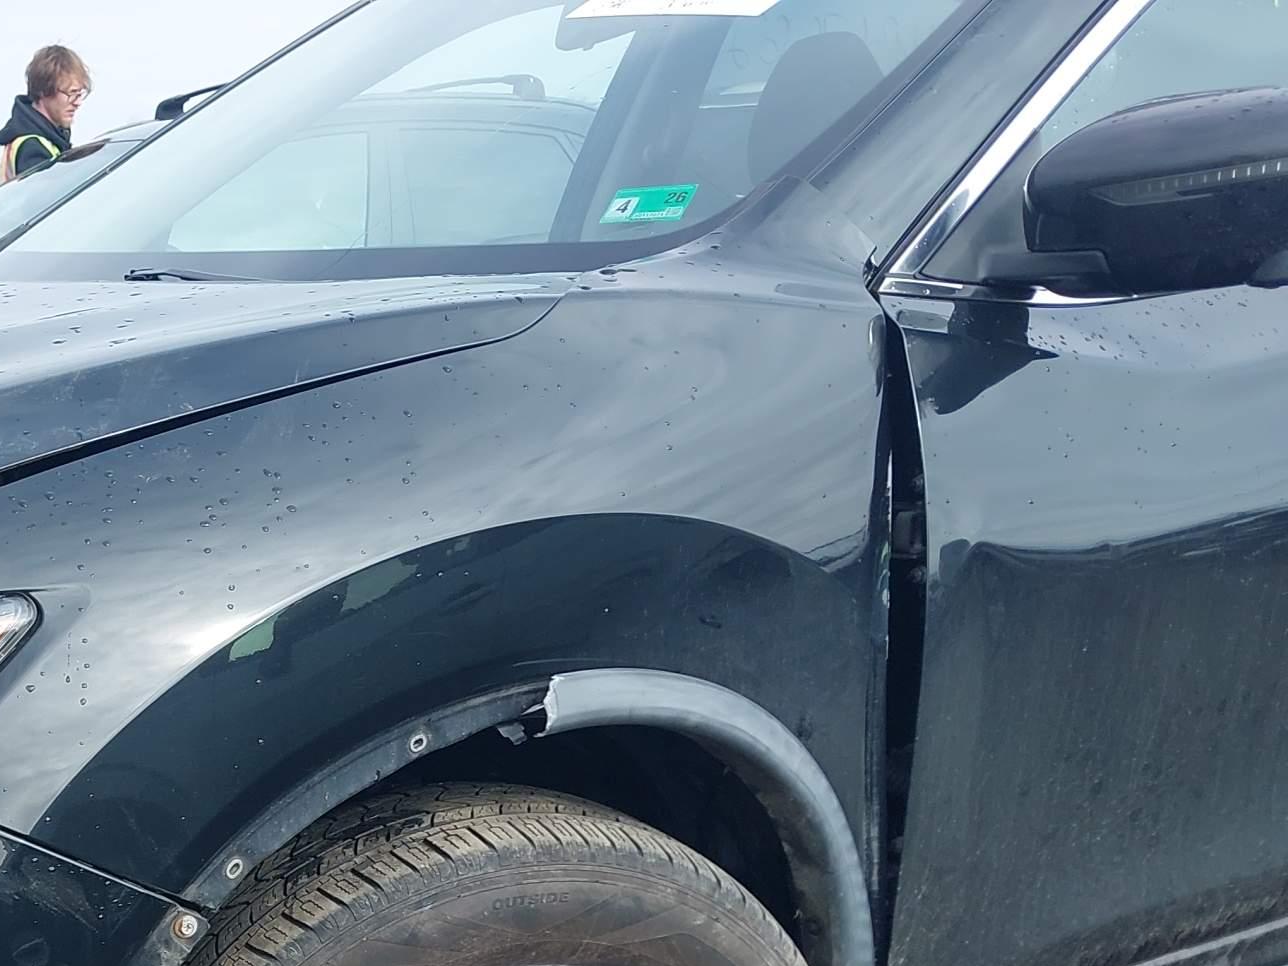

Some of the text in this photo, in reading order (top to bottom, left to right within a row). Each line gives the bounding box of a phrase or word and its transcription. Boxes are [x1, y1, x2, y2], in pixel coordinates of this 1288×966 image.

[664, 191, 689, 204] 26
[615, 199, 632, 213] 4
[492, 892, 570, 910] OUTSIDE
